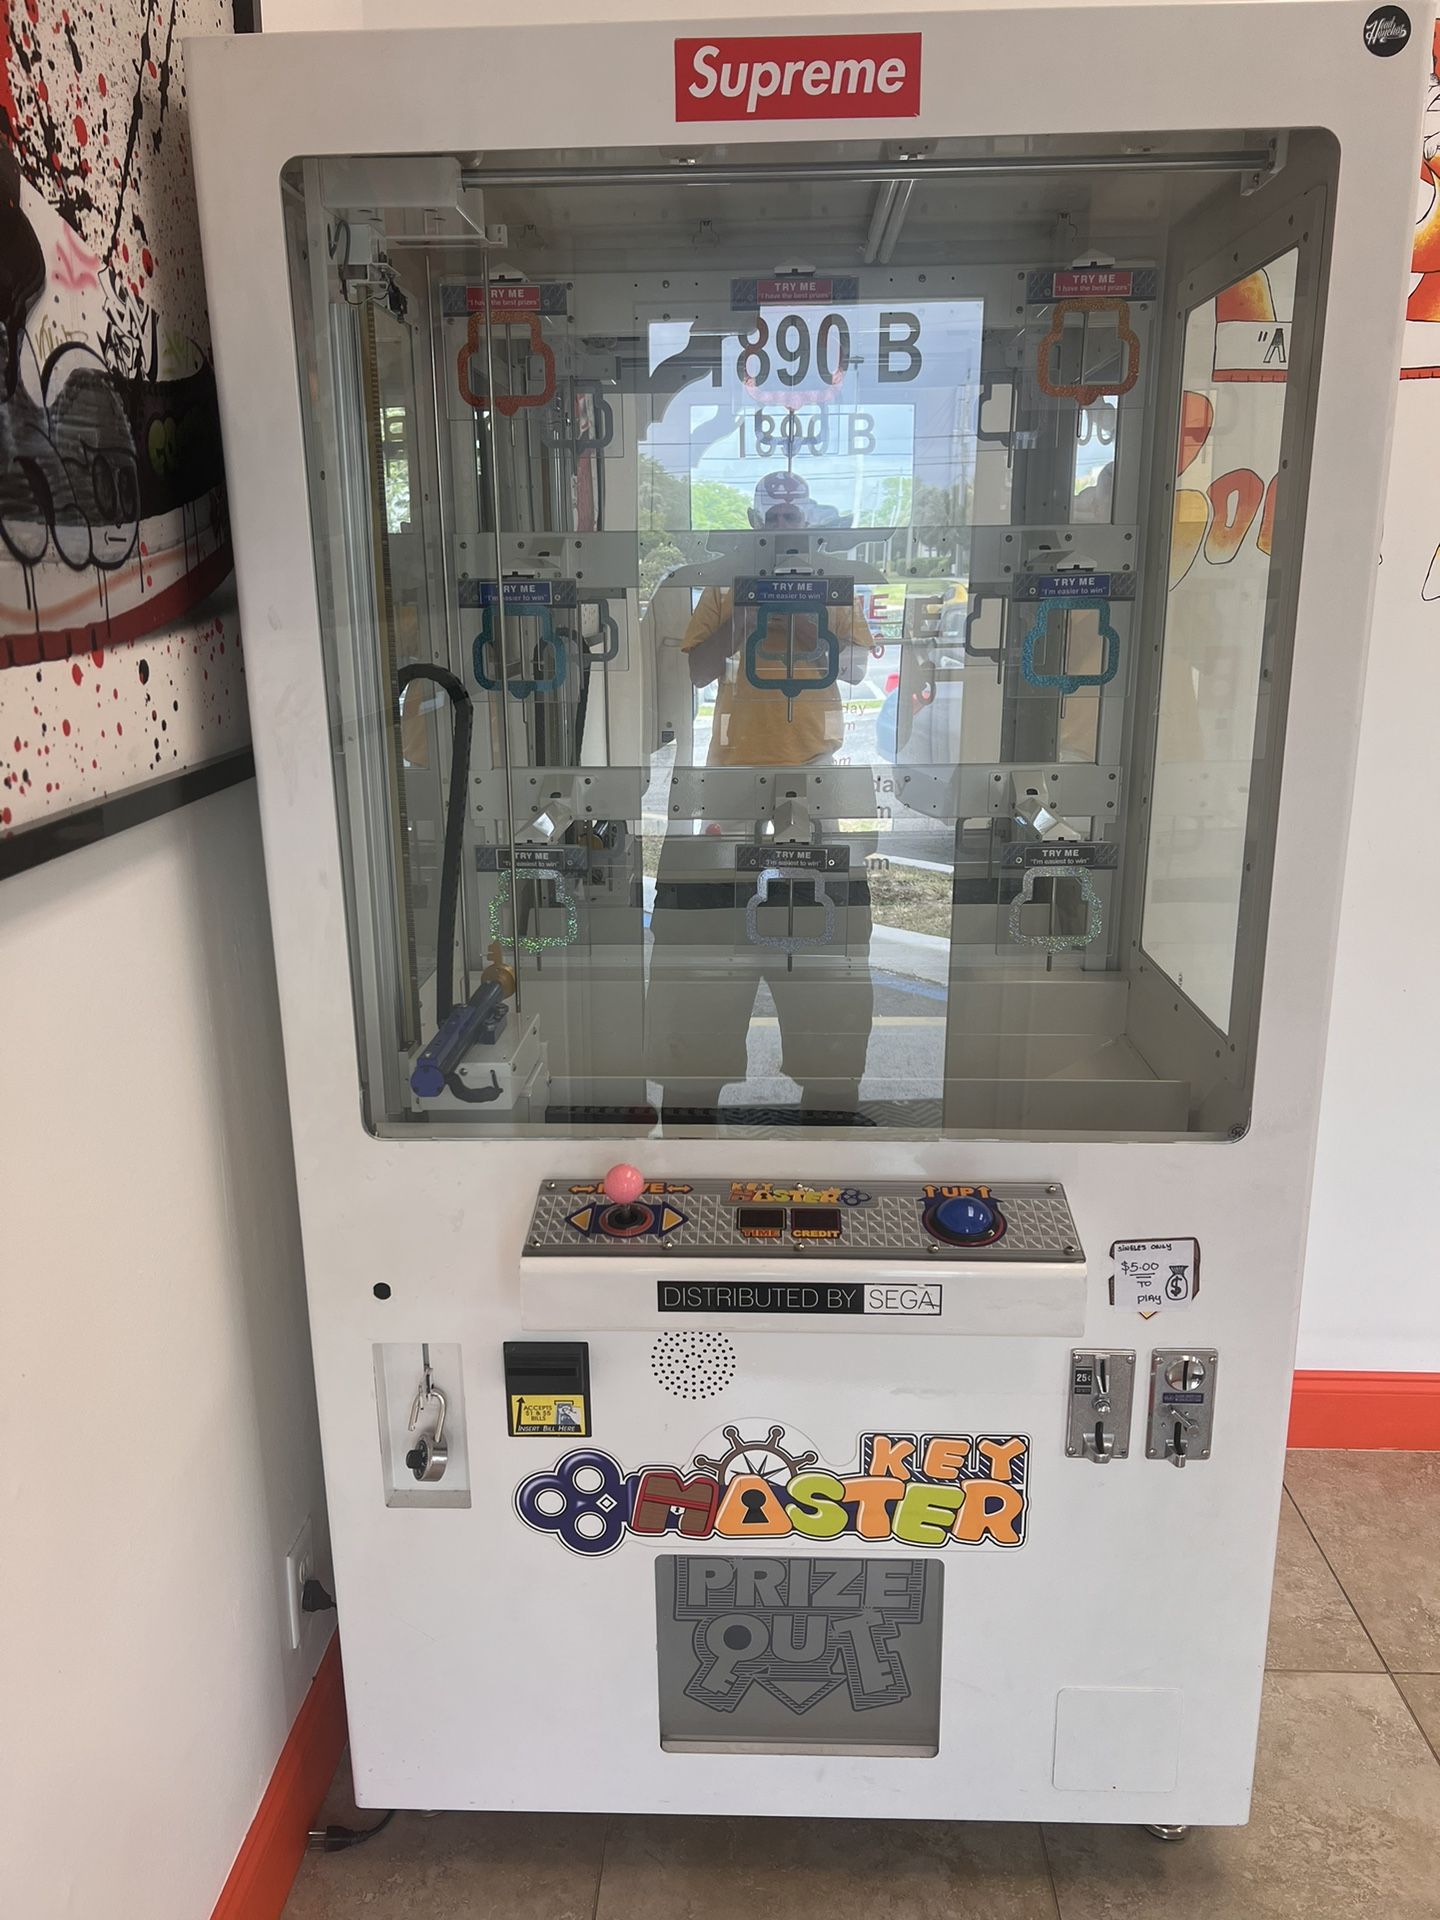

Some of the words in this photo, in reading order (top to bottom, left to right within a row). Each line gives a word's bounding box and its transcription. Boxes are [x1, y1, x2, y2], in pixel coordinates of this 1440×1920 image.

[689, 45, 906, 113] Supreme
[1073, 275, 1095, 284] TRY
[1098, 274, 1116, 283] ME
[774, 282, 796, 292] TRY
[800, 282, 817, 291] ME
[508, 289, 525, 298] ME
[877, 311, 922, 383] B
[847, 412, 876, 454] B
[772, 582, 794, 591] TRY
[797, 582, 813, 591] ME
[1053, 578, 1075, 587] TRY
[1079, 577, 1096, 586] ME
[520, 584, 536, 593] ME
[1080, 586, 1089, 594] to
[535, 852, 549, 860] ME
[776, 851, 795, 859] TRY
[798, 851, 811, 859] ME
[1042, 849, 1062, 857] TRY
[1064, 849, 1080, 857] ME
[941, 1187, 974, 1197] UP
[741, 1229, 781, 1238] TIME
[791, 1229, 840, 1238] CREDIT
[1120, 1260, 1160, 1275] $5.00
[1136, 1280, 1152, 1288] TO
[664, 1286, 819, 1308] DISTRIBUTED
[827, 1288, 857, 1308] BY
[868, 1289, 936, 1310] SEGA
[869, 1435, 1029, 1482] KEY
[631, 1472, 1025, 1545] MASTER
[686, 1558, 913, 1608] PRIZE
[699, 1609, 898, 1697] OUT
